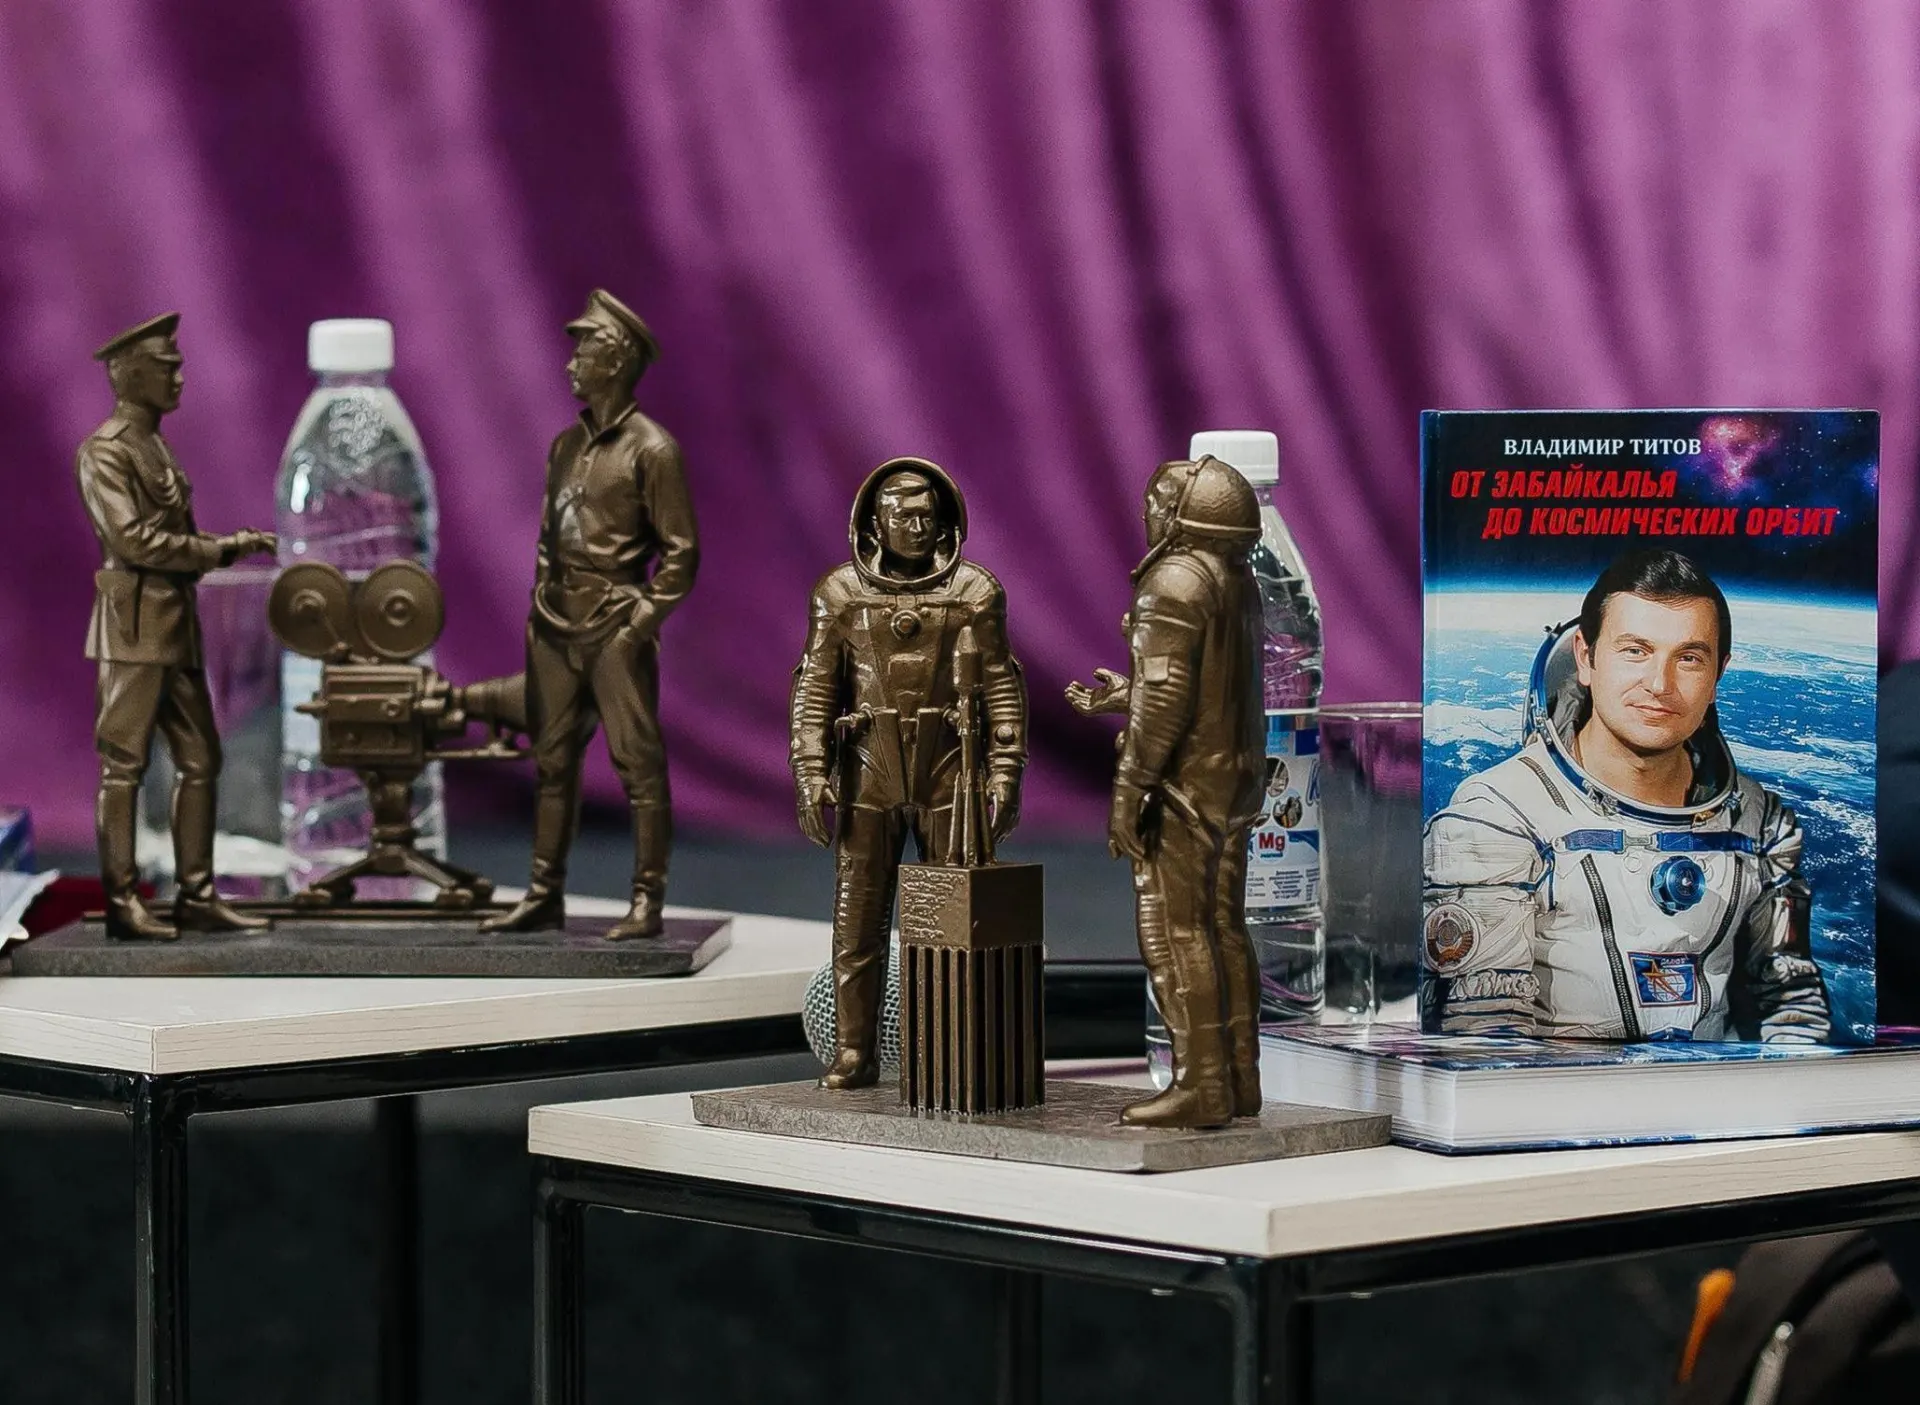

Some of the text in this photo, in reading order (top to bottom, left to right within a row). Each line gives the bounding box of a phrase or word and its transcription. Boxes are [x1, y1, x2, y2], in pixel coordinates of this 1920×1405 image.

[1504, 438, 1702, 458] ВЛАДИМИР ТИТОВ
[1450, 463, 1678, 499] ОТ ЗАБАЙКАЛЬЯ
[1481, 507, 1838, 540] ДО КОСМИЧЕСКИХ ОРБИТ
[1258, 832, 1285, 852] Mg
